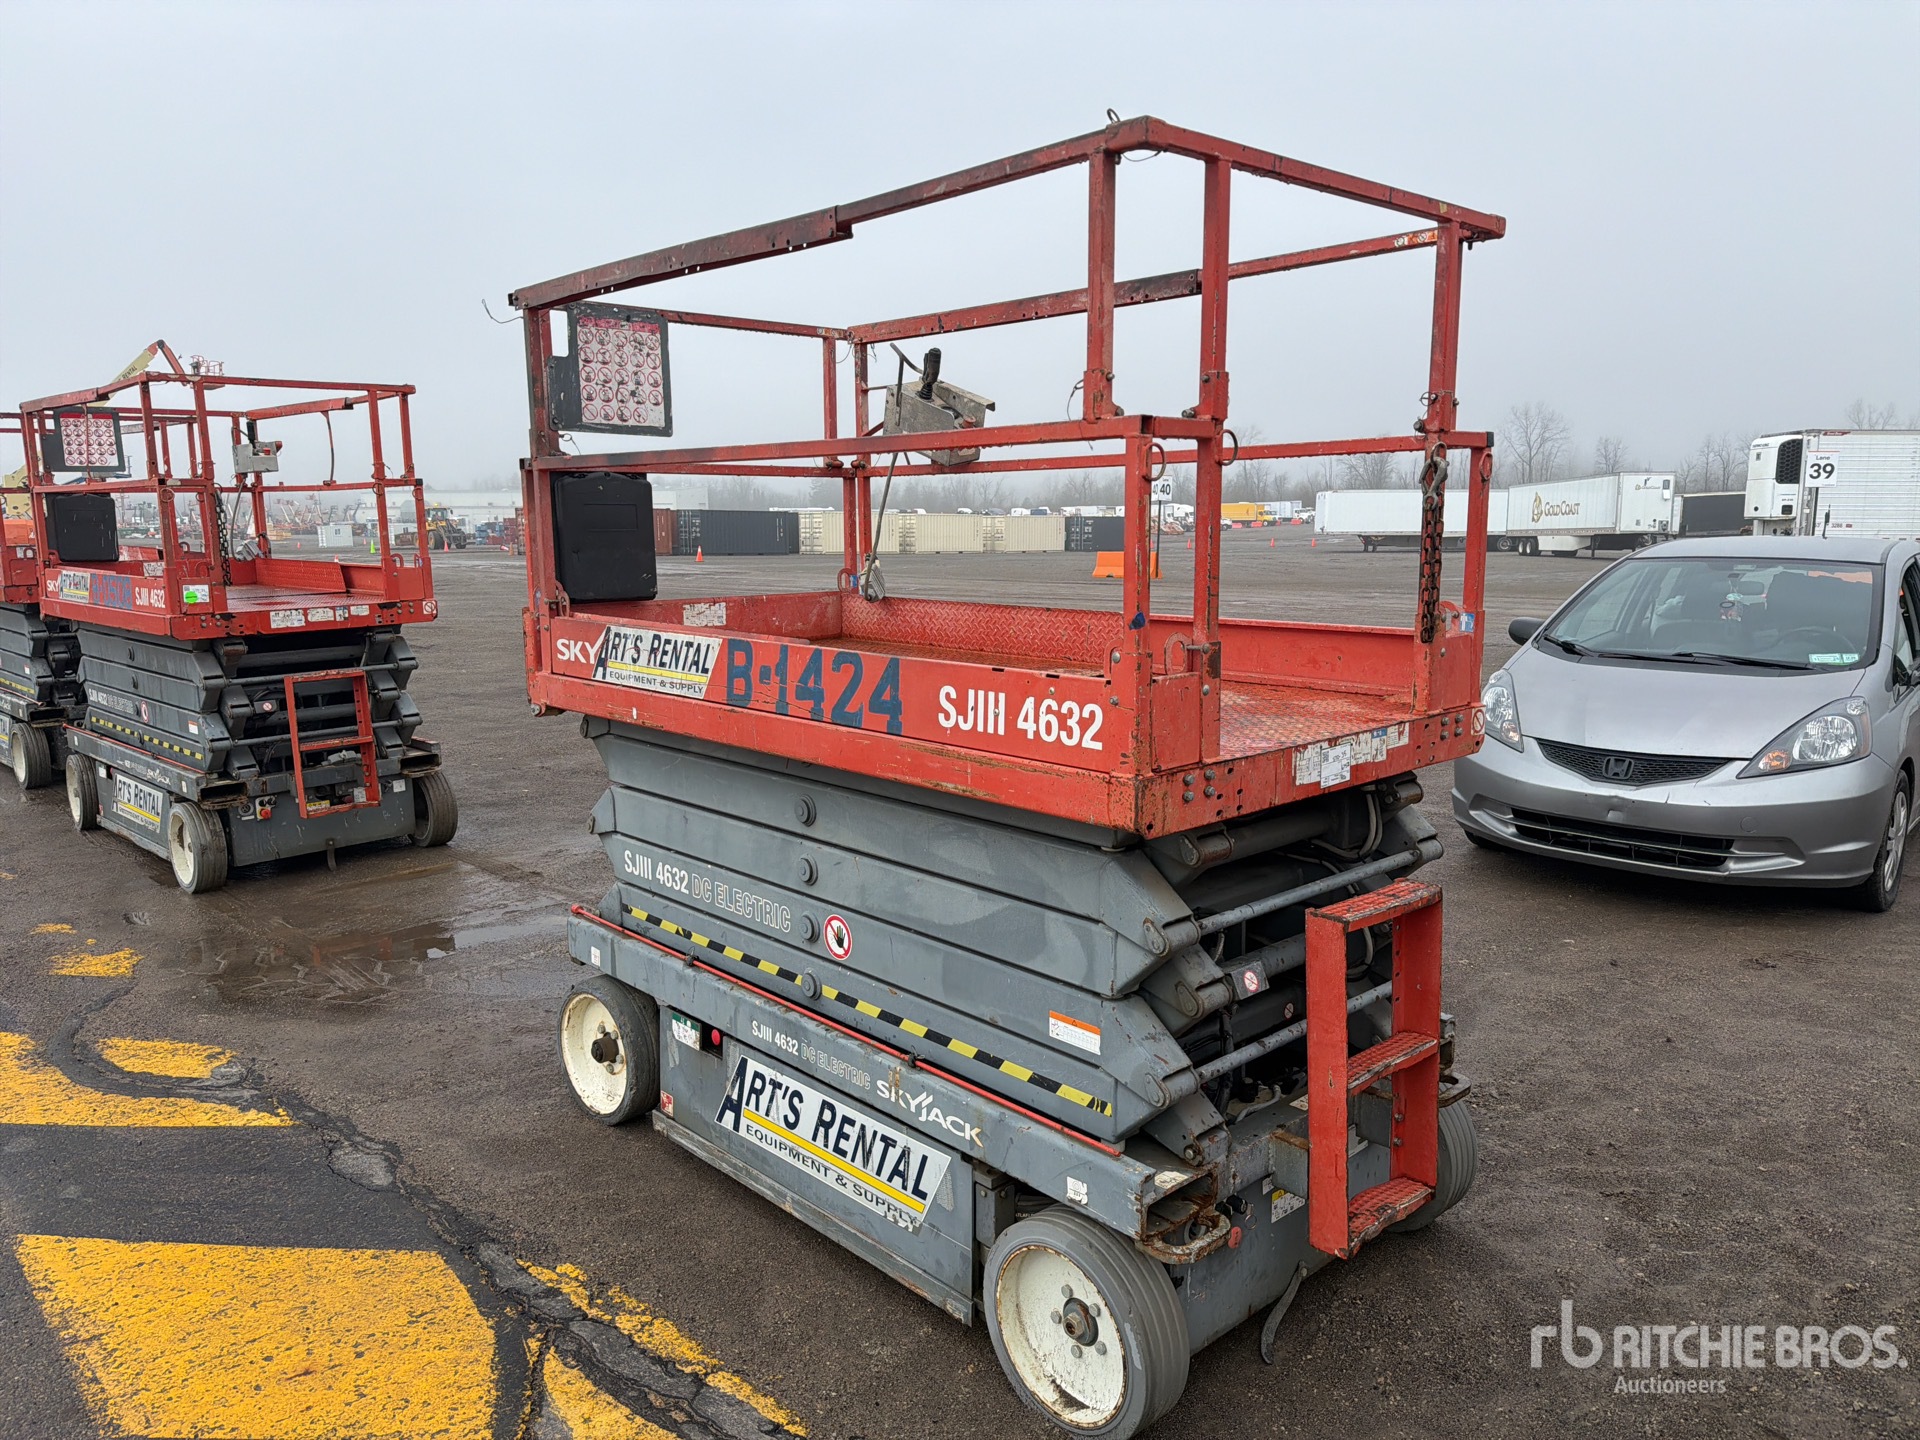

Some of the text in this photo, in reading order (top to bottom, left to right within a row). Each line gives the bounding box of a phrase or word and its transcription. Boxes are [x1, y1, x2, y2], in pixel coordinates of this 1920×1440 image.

[1160, 483, 1171, 495] 40
[1809, 462, 1835, 479] 39
[150, 588, 166, 609] 4632
[556, 638, 602, 664] SKY
[593, 626, 712, 680] ART'S RENTAL
[609, 670, 704, 694] EQUIPMENT & SUPPLY
[726, 637, 903, 736] B-1424
[938, 685, 1104, 751] SJIII 4632
[134, 783, 160, 816] RENTAL
[624, 849, 792, 933] SJIII 4632 DC ELECTRIC
[751, 1020, 871, 1091] SJIII 4632 DC ELECTRIC
[716, 1056, 929, 1201] ART'S RENTAL
[875, 1078, 985, 1149] SKYJACK
[746, 1124, 919, 1226] EQUIPMENT & SUPPLY
